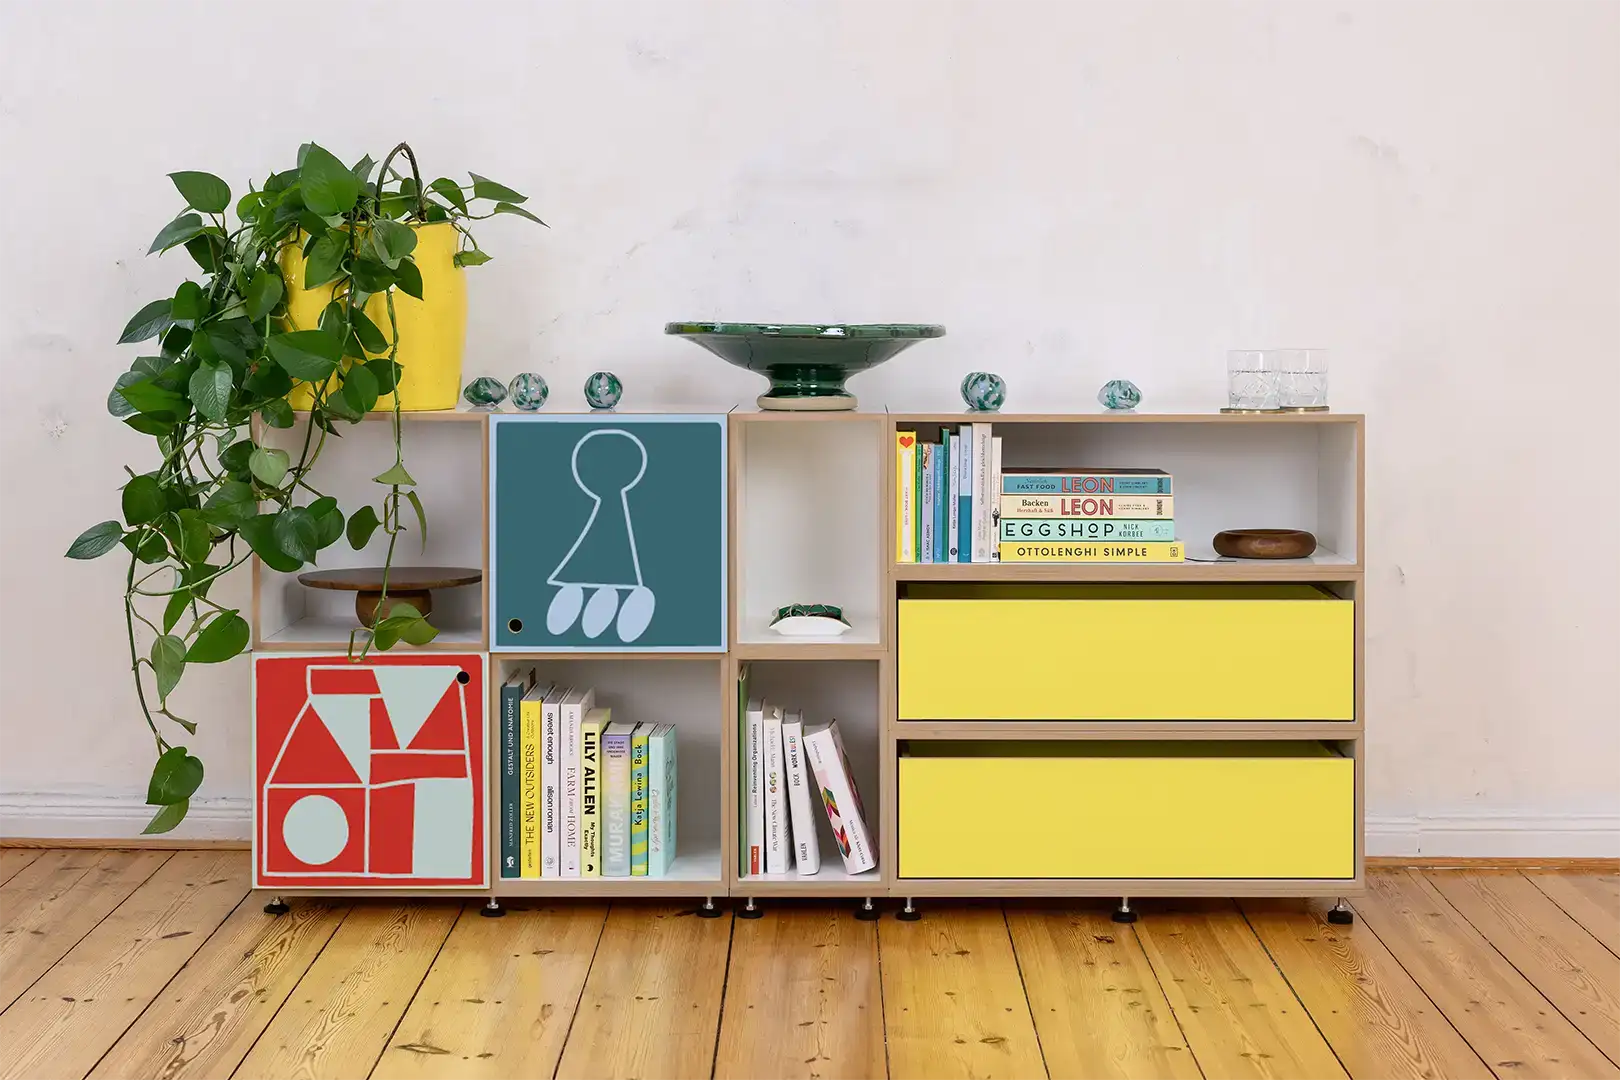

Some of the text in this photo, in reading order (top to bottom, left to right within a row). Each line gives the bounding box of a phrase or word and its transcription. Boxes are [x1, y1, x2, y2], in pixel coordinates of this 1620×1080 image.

[1061, 477, 1115, 493] LEON
[1021, 499, 1049, 507] Backen
[1060, 498, 1114, 516] LEON
[1016, 547, 1147, 557] OTTOLENGHI SIMPLE
[545, 712, 555, 765] sweet enough
[634, 744, 643, 765] Bock
[751, 724, 759, 794] Reinventing Organizations
[791, 753, 799, 768] WORK
[567, 767, 576, 797] FARM
[584, 732, 596, 815] LILY ALLEN
[793, 773, 801, 786] BOCK
[525, 745, 535, 845] THE NEW OUTSIDERS
[547, 786, 555, 808] alison
[634, 772, 644, 825] Katja Lewina
[608, 759, 624, 862] MURAKAMI
[567, 815, 576, 848] HOME
[589, 822, 596, 830] My
